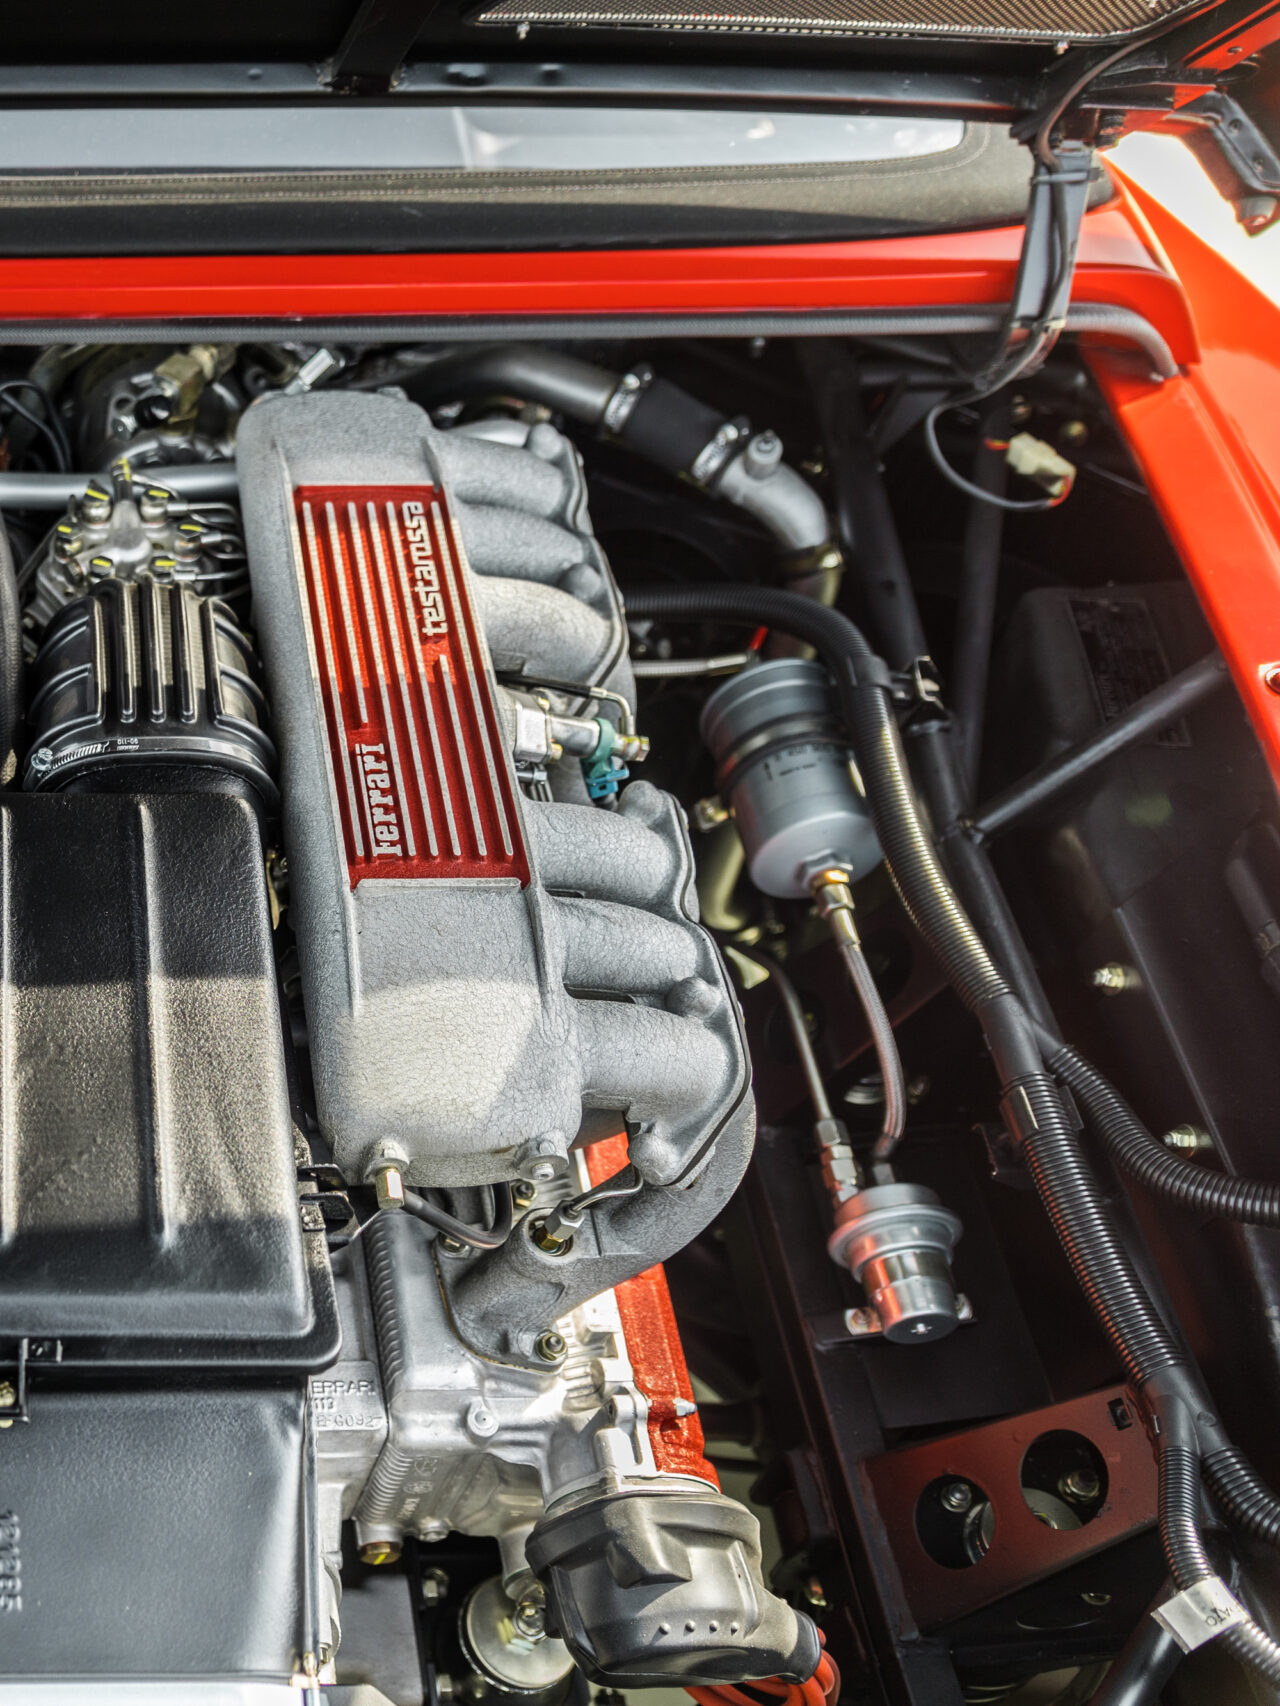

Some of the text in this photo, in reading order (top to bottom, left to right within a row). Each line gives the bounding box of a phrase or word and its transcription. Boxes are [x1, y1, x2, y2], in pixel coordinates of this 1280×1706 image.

[401, 501, 448, 637] testarossa
[354, 743, 403, 858] Ferrari
[311, 1380, 376, 1396] ERRARI
